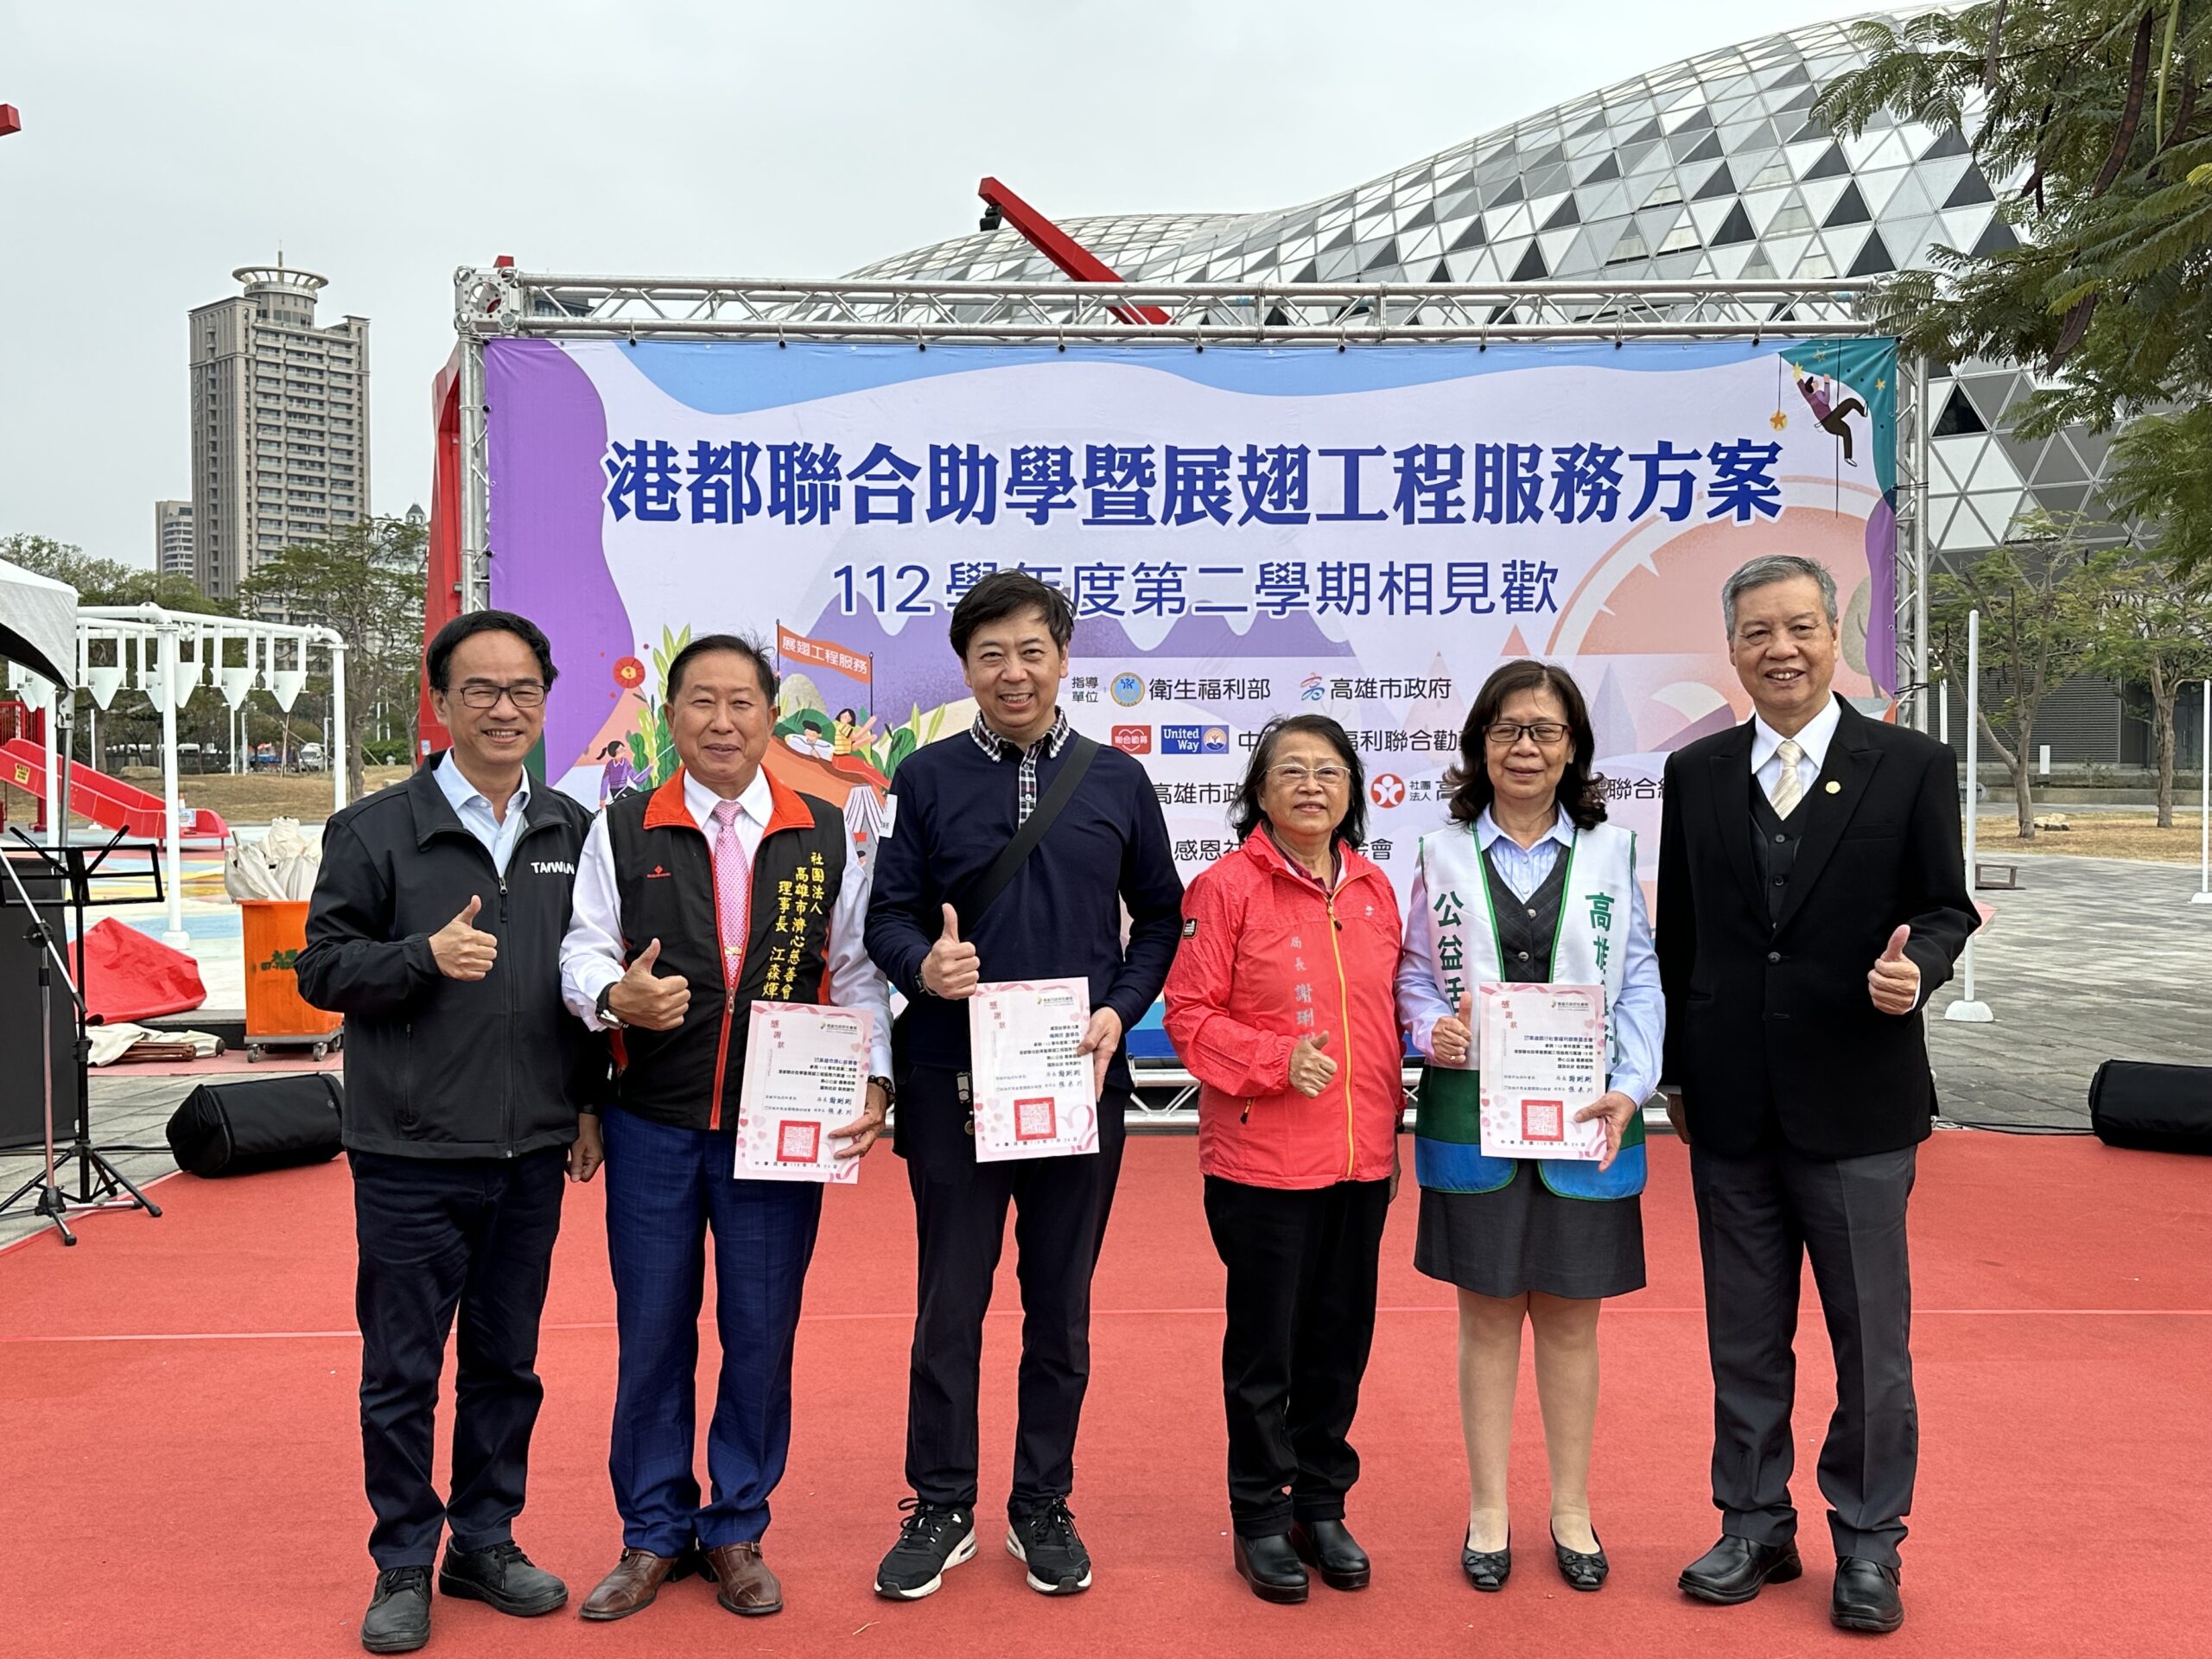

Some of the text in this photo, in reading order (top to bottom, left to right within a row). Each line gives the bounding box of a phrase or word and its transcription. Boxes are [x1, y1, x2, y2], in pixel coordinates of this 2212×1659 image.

[605, 438, 1784, 526] 港都聯合助學暨展翅工程服務方案
[782, 636, 867, 675] 展翅工程服務
[1149, 678, 1270, 701] 衛生福利部
[1330, 677, 1452, 701] 高雄市政府
[1164, 729, 1199, 739] United
[1179, 741, 1198, 753] Way
[810, 852, 825, 915] 社團法人
[775, 880, 792, 933] 理事長
